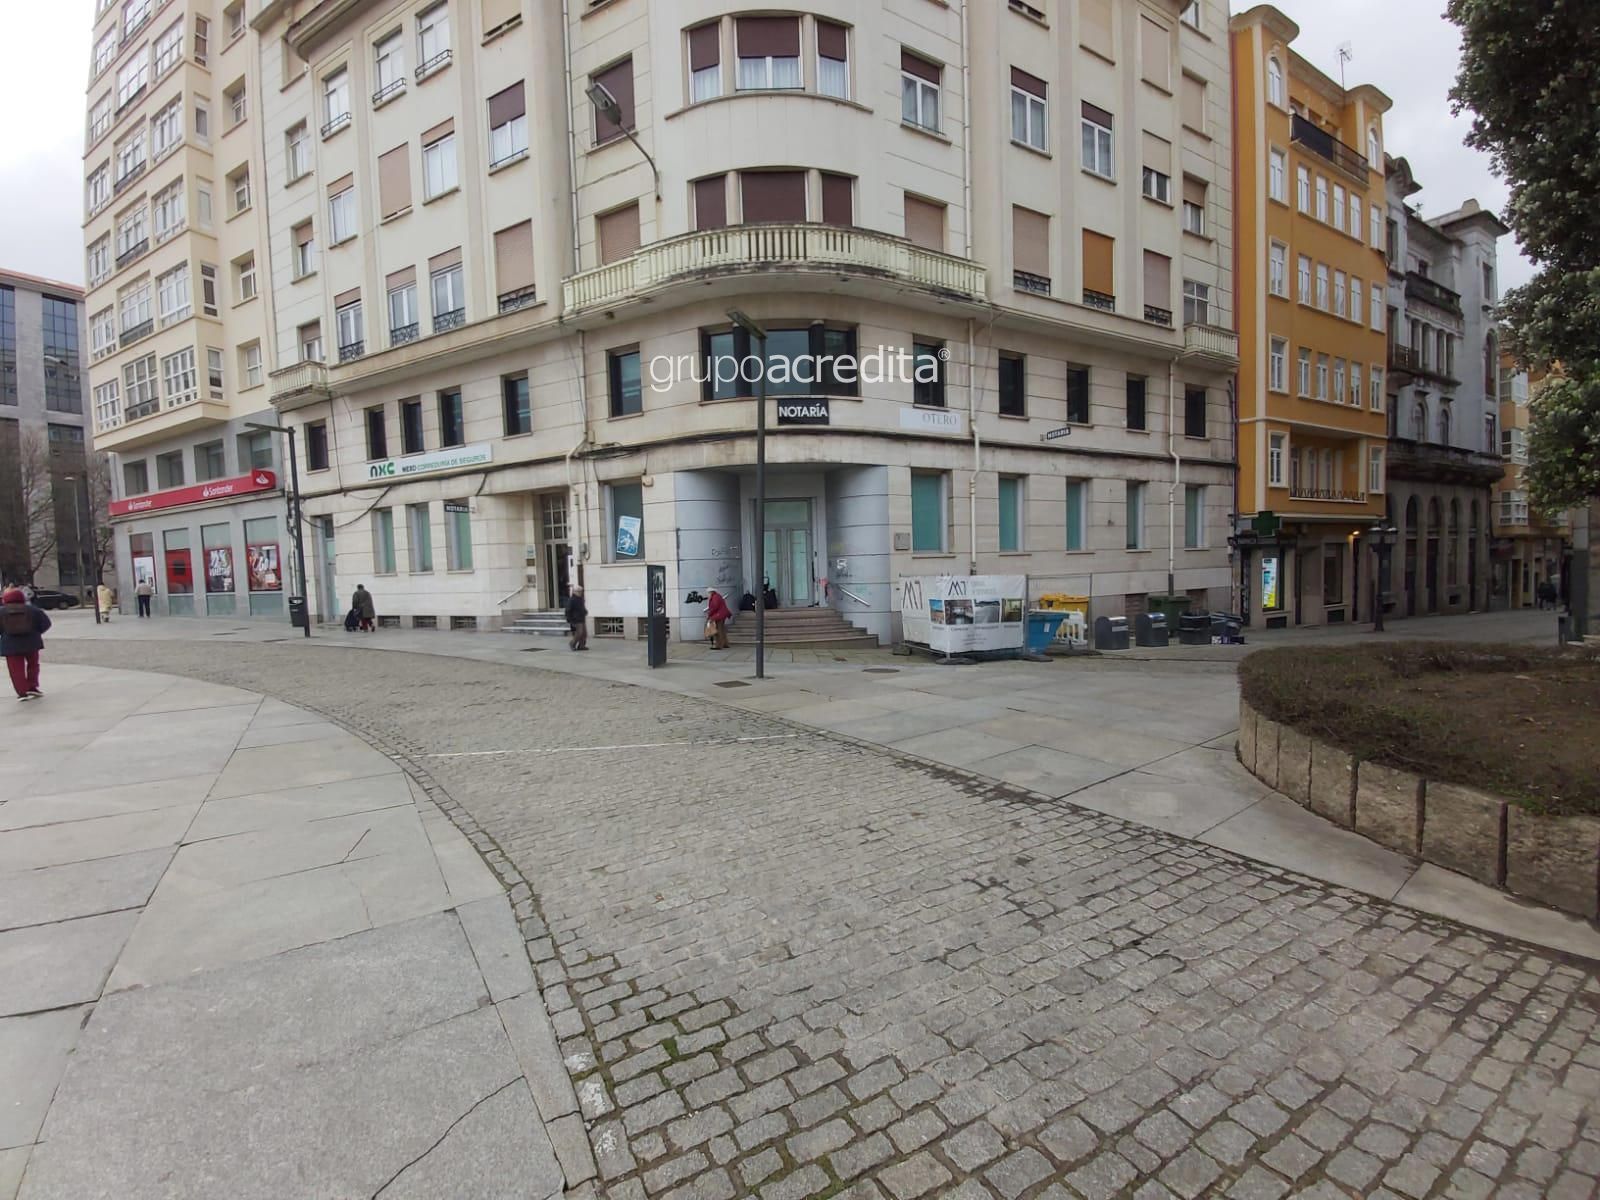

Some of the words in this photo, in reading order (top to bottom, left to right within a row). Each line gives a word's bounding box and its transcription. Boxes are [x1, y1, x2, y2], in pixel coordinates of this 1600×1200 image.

[778, 403, 828, 418] NOTARÍA
[922, 412, 957, 425] OTERO
[208, 484, 233, 496] Santander
